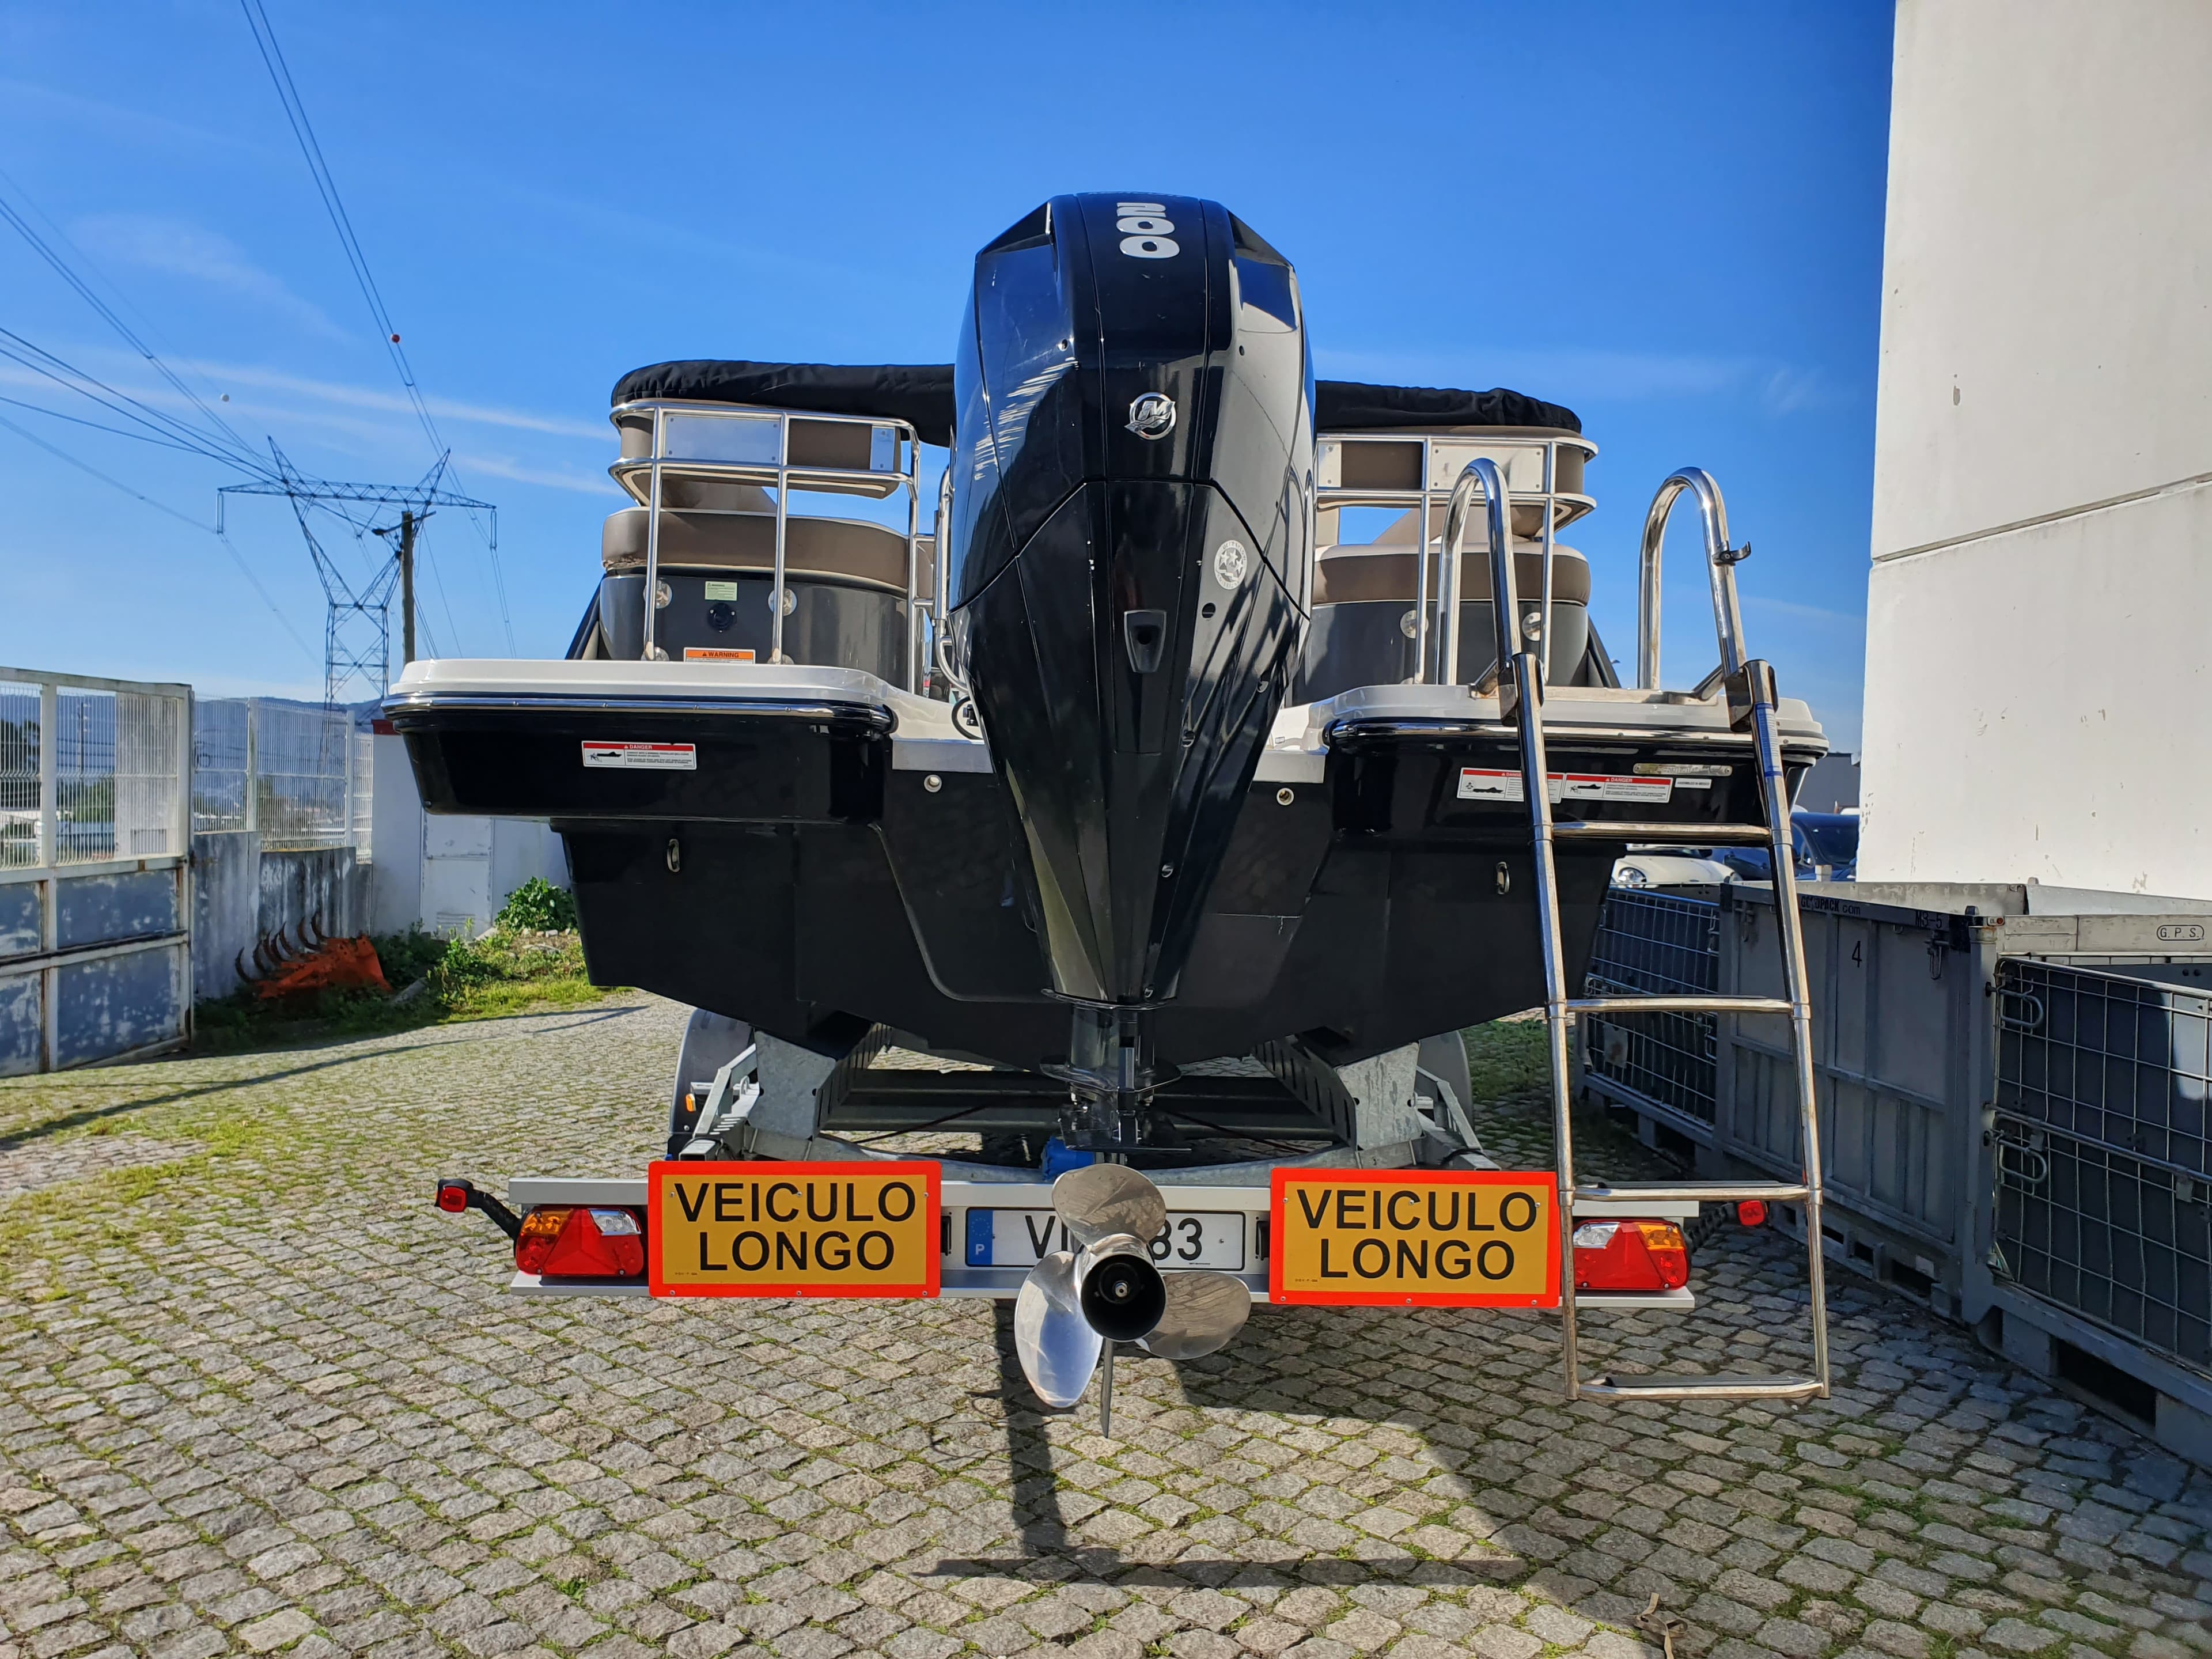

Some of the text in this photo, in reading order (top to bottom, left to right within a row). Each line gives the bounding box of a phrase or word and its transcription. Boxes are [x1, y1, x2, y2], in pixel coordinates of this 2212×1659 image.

[1116, 202, 1180, 259] 200
[1851, 940, 1862, 968] 4
[674, 1181, 916, 1223] VEICULO
[1296, 1189, 1537, 1233] VEICULO
[699, 1230, 895, 1271] LONGO
[975, 1243, 986, 1256] P
[1320, 1238, 1515, 1280] LONGO
